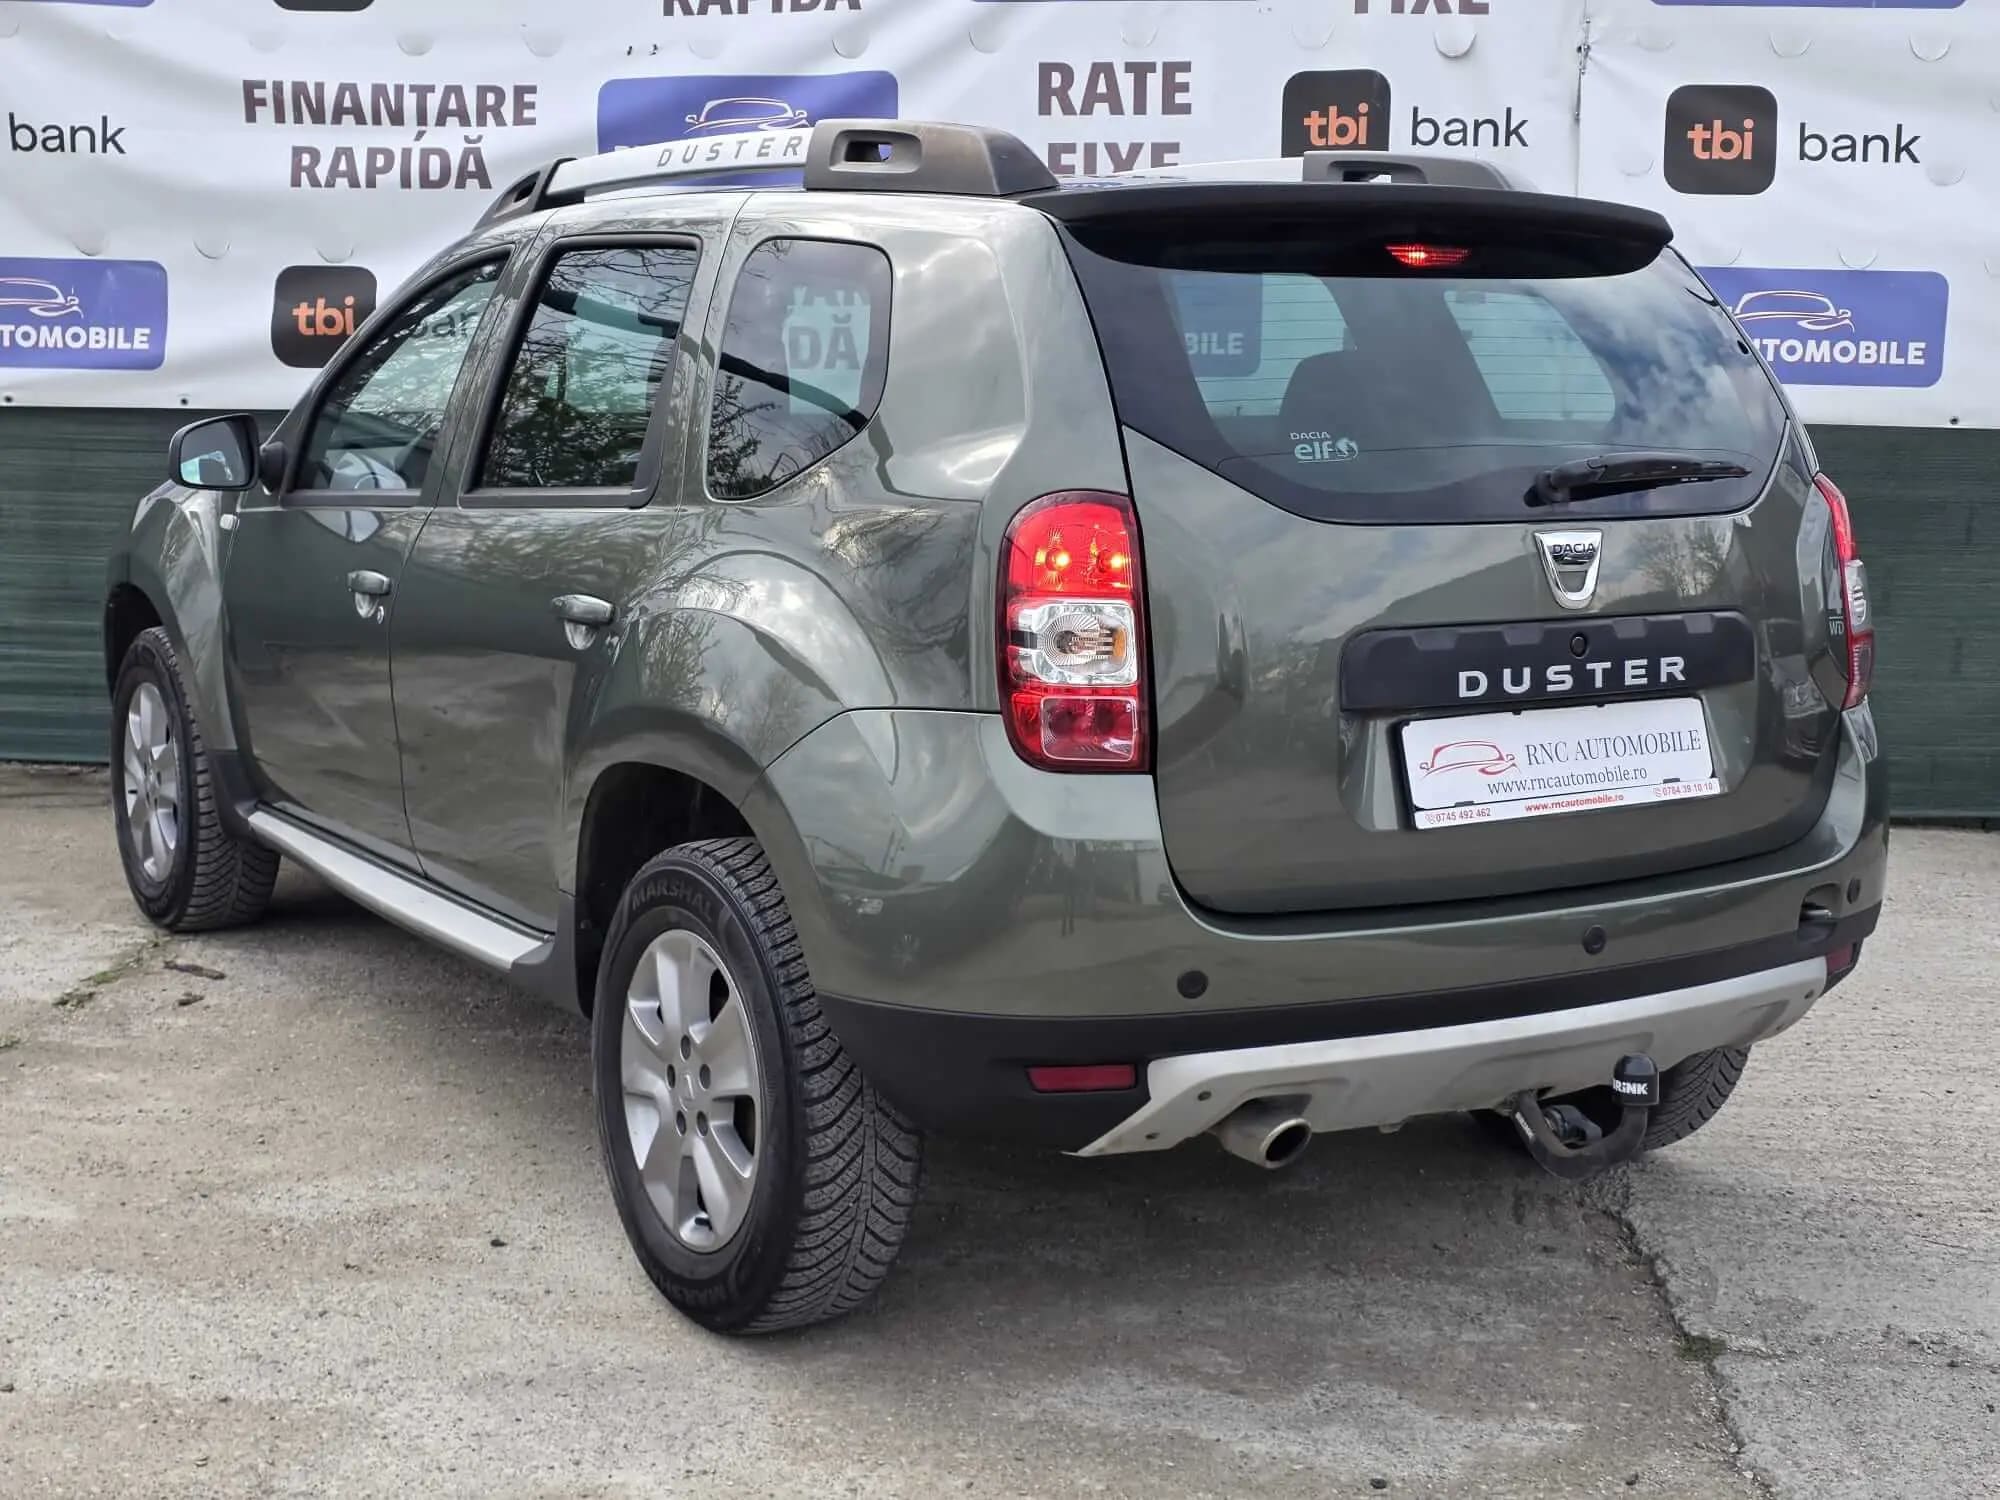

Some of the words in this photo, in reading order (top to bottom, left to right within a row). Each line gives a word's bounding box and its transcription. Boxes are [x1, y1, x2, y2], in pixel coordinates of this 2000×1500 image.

[1038, 61, 1192, 117] RATE
[9, 113, 127, 156] bank
[1304, 103, 1368, 147] tbi
[1411, 107, 1529, 148] bank
[1687, 118, 1754, 161] tbi
[1800, 123, 1921, 165] bank
[656, 135, 804, 168] DUSTER
[291, 295, 356, 336] tbi
[1290, 431, 1331, 440] DACIA
[1294, 440, 1333, 460] elf
[1552, 543, 1597, 555] DACIA
[1458, 655, 1687, 698] DUSTER
[1525, 741, 1569, 766] RNC
[1575, 729, 1702, 761] AUTOMOBILE
[1488, 765, 1648, 796] www.rncautomobile.ro
[1524, 793, 1625, 813] www.rncautomobile.ro
